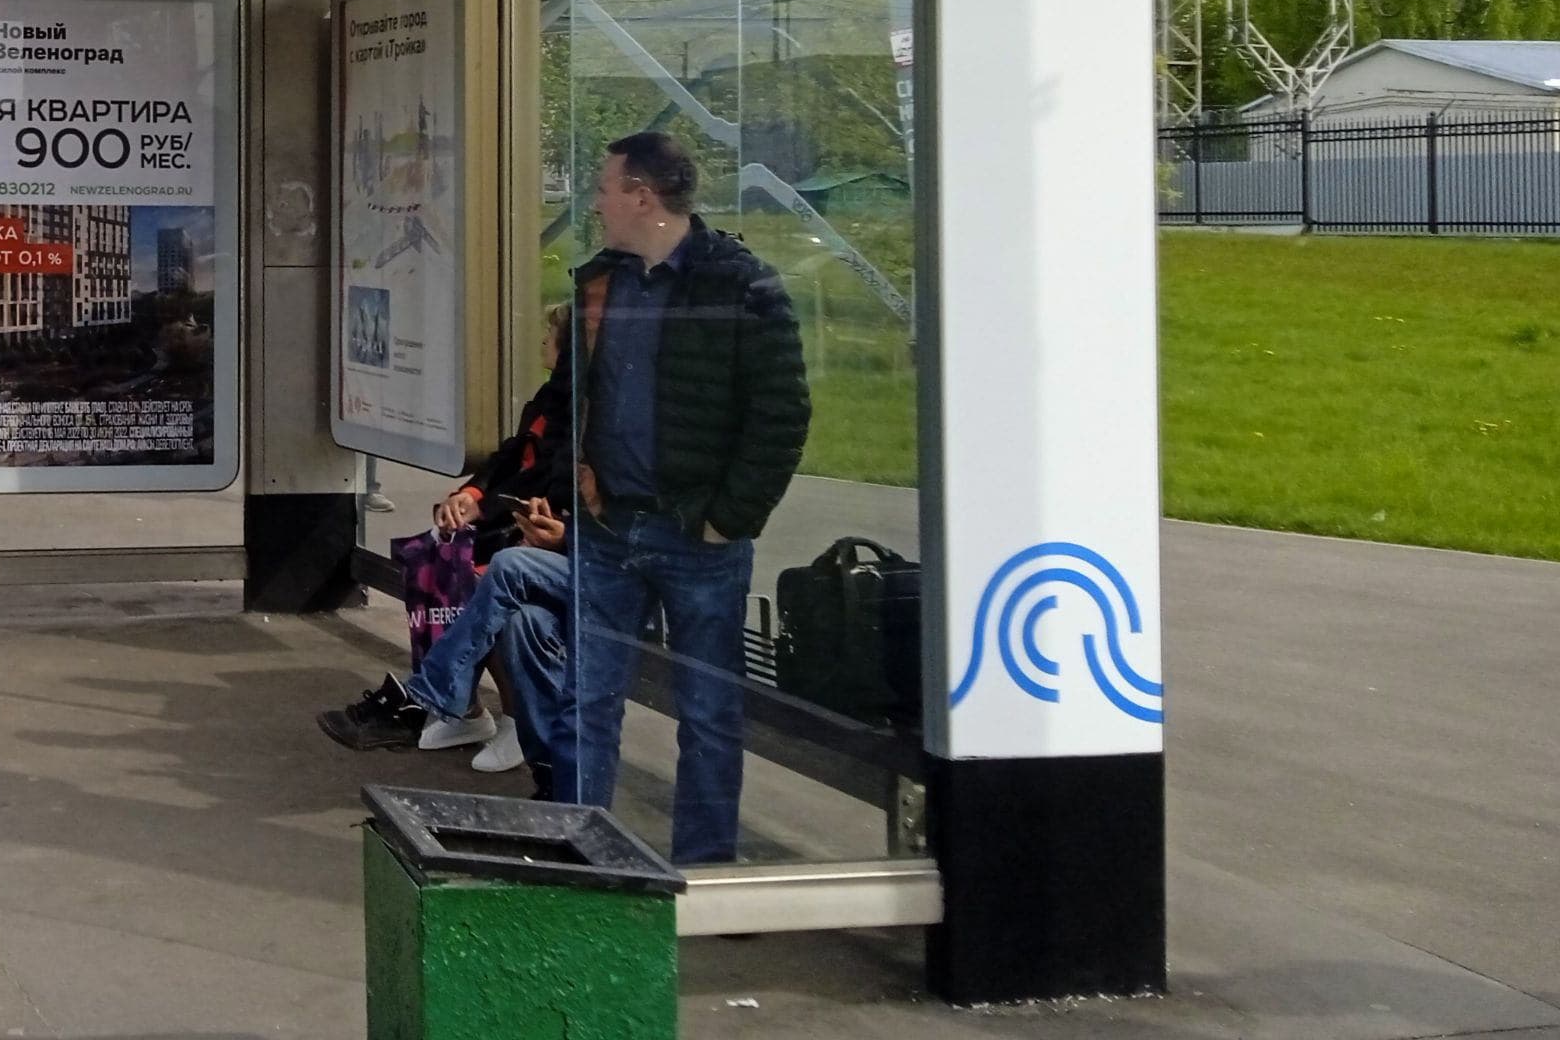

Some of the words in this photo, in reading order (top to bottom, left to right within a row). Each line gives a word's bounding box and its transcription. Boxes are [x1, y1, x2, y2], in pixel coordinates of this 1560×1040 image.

[350, 14, 399, 38] Открывайте
[400, 10, 428, 29] город
[355, 42, 383, 64] картой
[24, 67, 67, 75] комплекс
[28, 99, 193, 124] КВАРТИРА
[15, 127, 131, 169] 900
[140, 131, 193, 152] РУБ/
[140, 152, 192, 169] МЕС.
[70, 185, 193, 197] NEWZELENOGRAD.RU
[19, 250, 43, 267] 0,1
[48, 252, 62, 266] %
